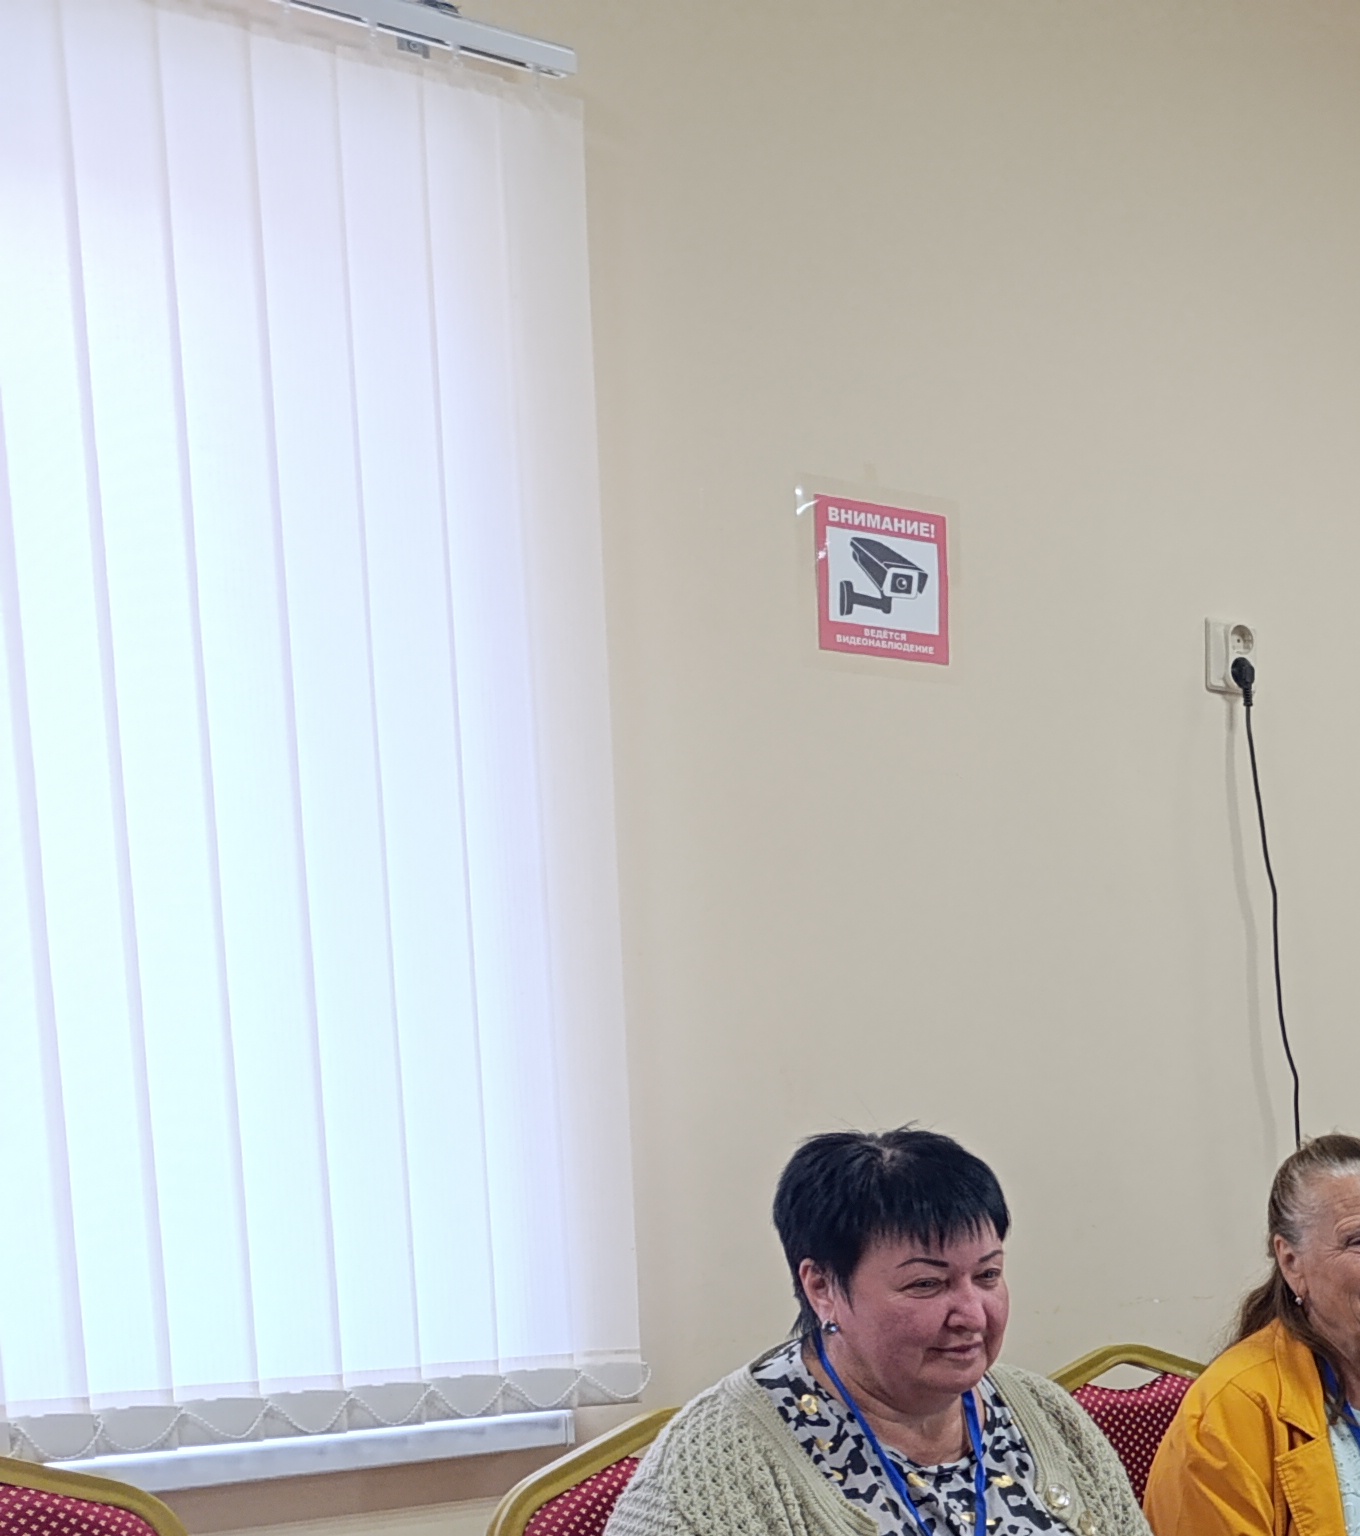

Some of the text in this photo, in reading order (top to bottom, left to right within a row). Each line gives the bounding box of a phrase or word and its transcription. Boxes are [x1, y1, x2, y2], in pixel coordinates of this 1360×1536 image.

[827, 506, 936, 538] ВНИМАНИЕ!
[836, 633, 935, 655] ВИДЕОНАБЛЮДЕНИЕ
[863, 628, 907, 641] ВЕДЁТСЯ
